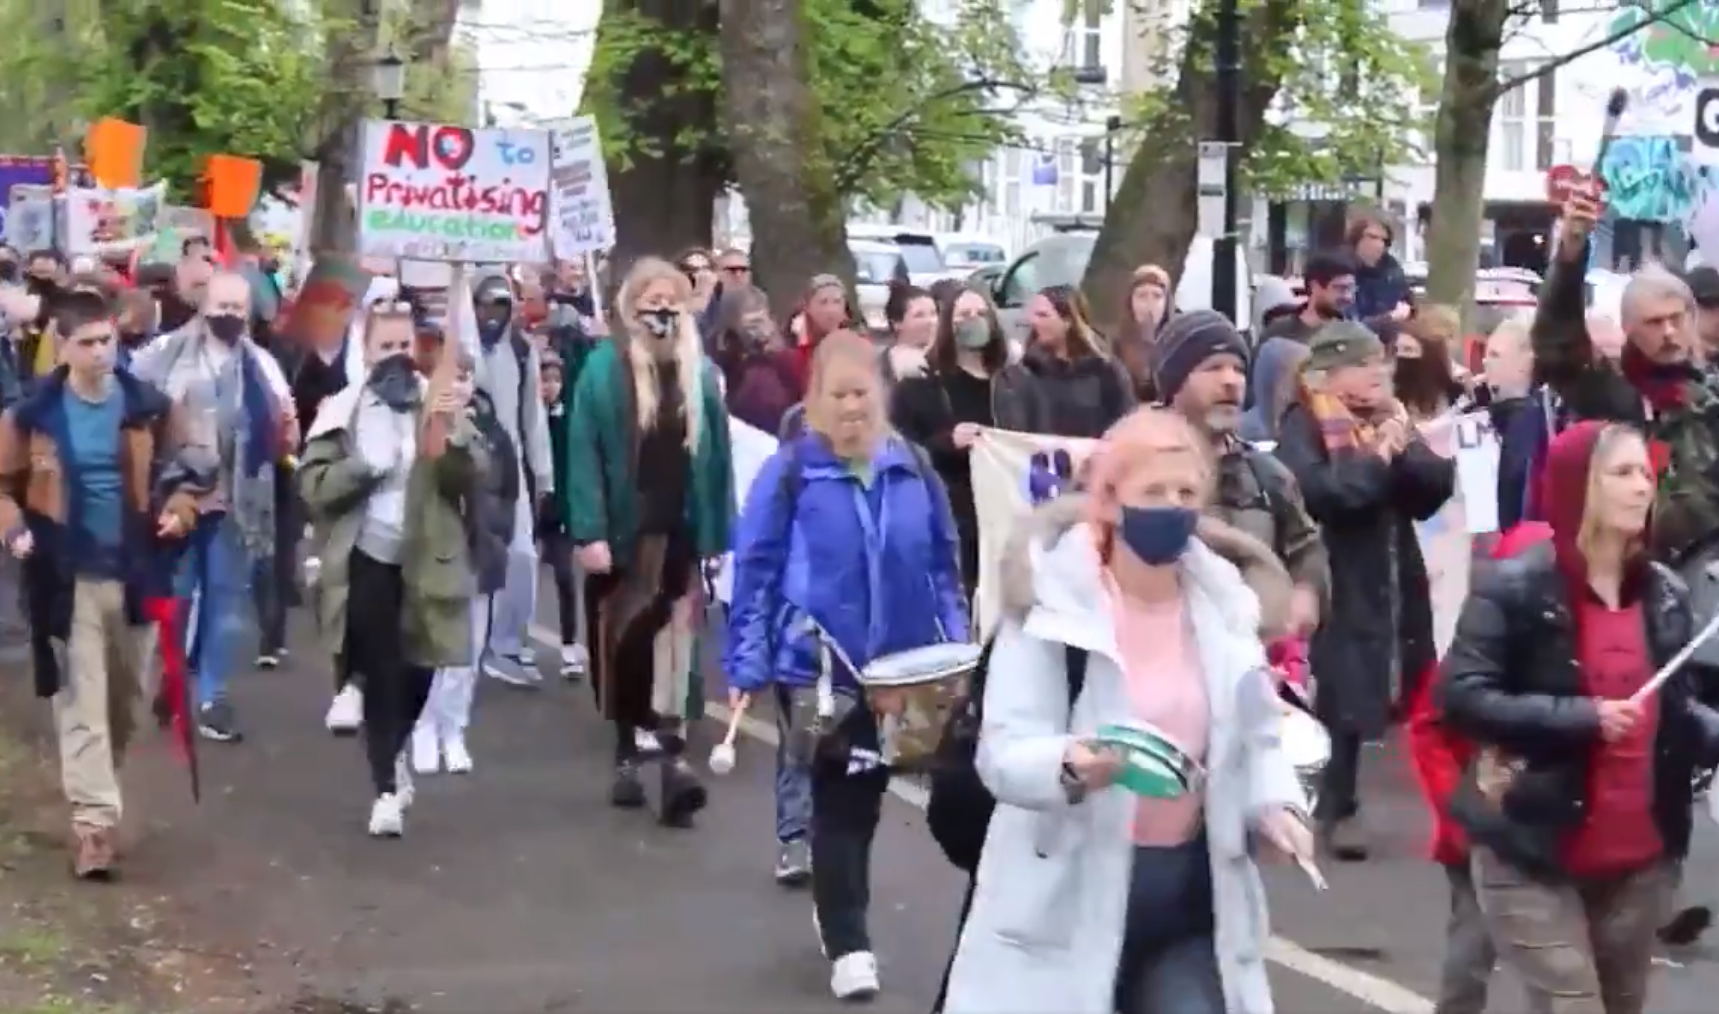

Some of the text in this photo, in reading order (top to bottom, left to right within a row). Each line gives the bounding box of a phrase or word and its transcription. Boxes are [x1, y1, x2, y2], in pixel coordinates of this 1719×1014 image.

[384, 124, 535, 170] NO to
[367, 172, 547, 234] Privatising
